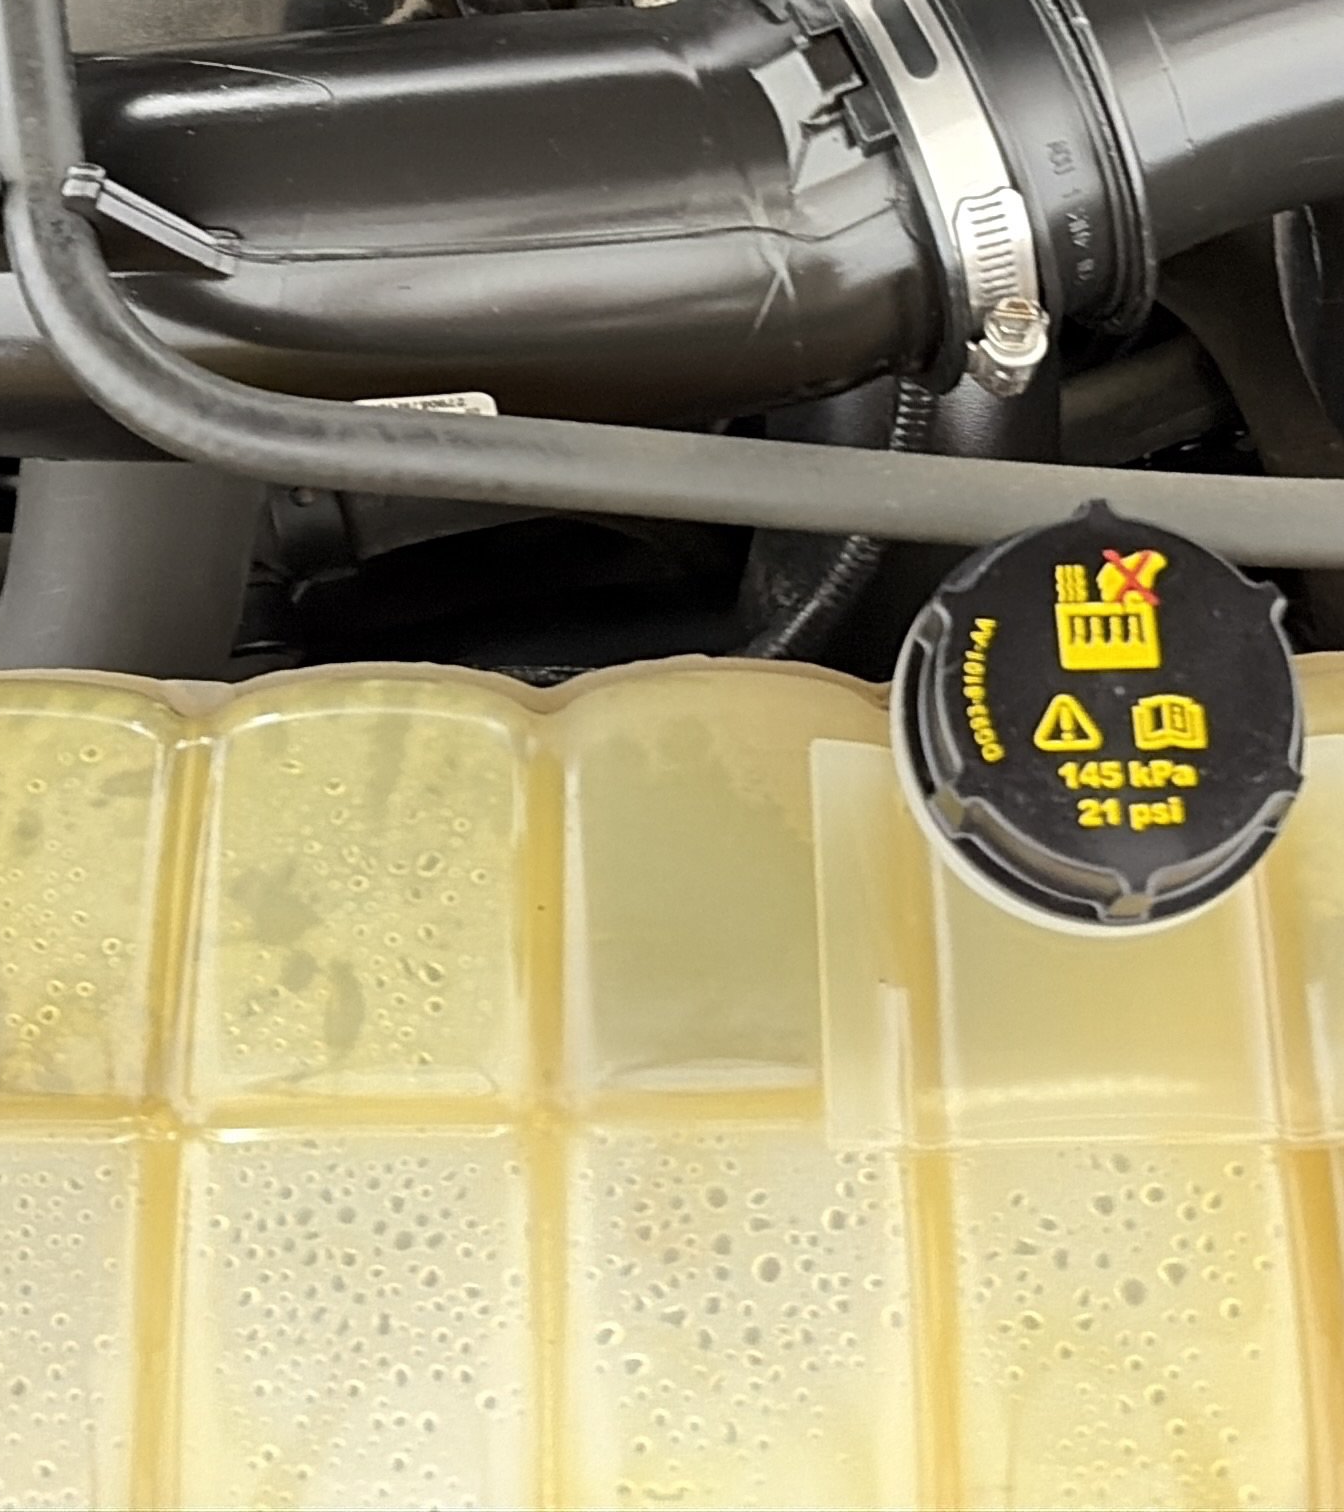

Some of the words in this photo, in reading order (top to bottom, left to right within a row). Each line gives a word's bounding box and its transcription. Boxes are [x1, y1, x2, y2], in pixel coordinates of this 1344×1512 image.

[1057, 760, 1126, 790] 145
[1127, 759, 1199, 788] kPa
[1077, 797, 1122, 827] 21
[1128, 795, 1186, 832] psi
